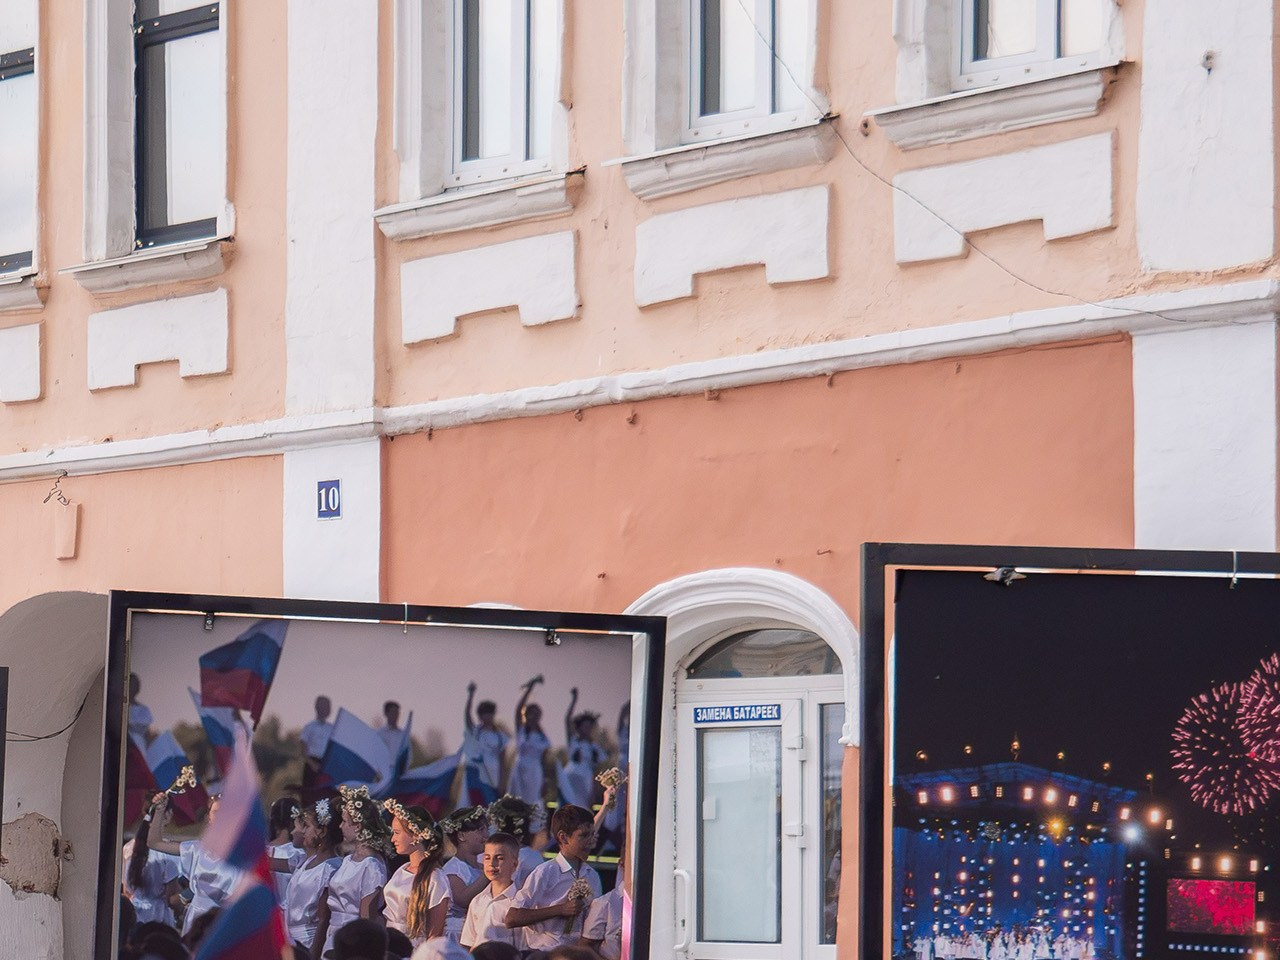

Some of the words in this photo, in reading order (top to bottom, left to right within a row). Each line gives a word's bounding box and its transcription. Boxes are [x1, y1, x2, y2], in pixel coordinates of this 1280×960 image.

[319, 487, 339, 511] 10
[696, 707, 732, 721] ЗАМЕНА
[733, 705, 778, 719] БАТАРЕЕК
